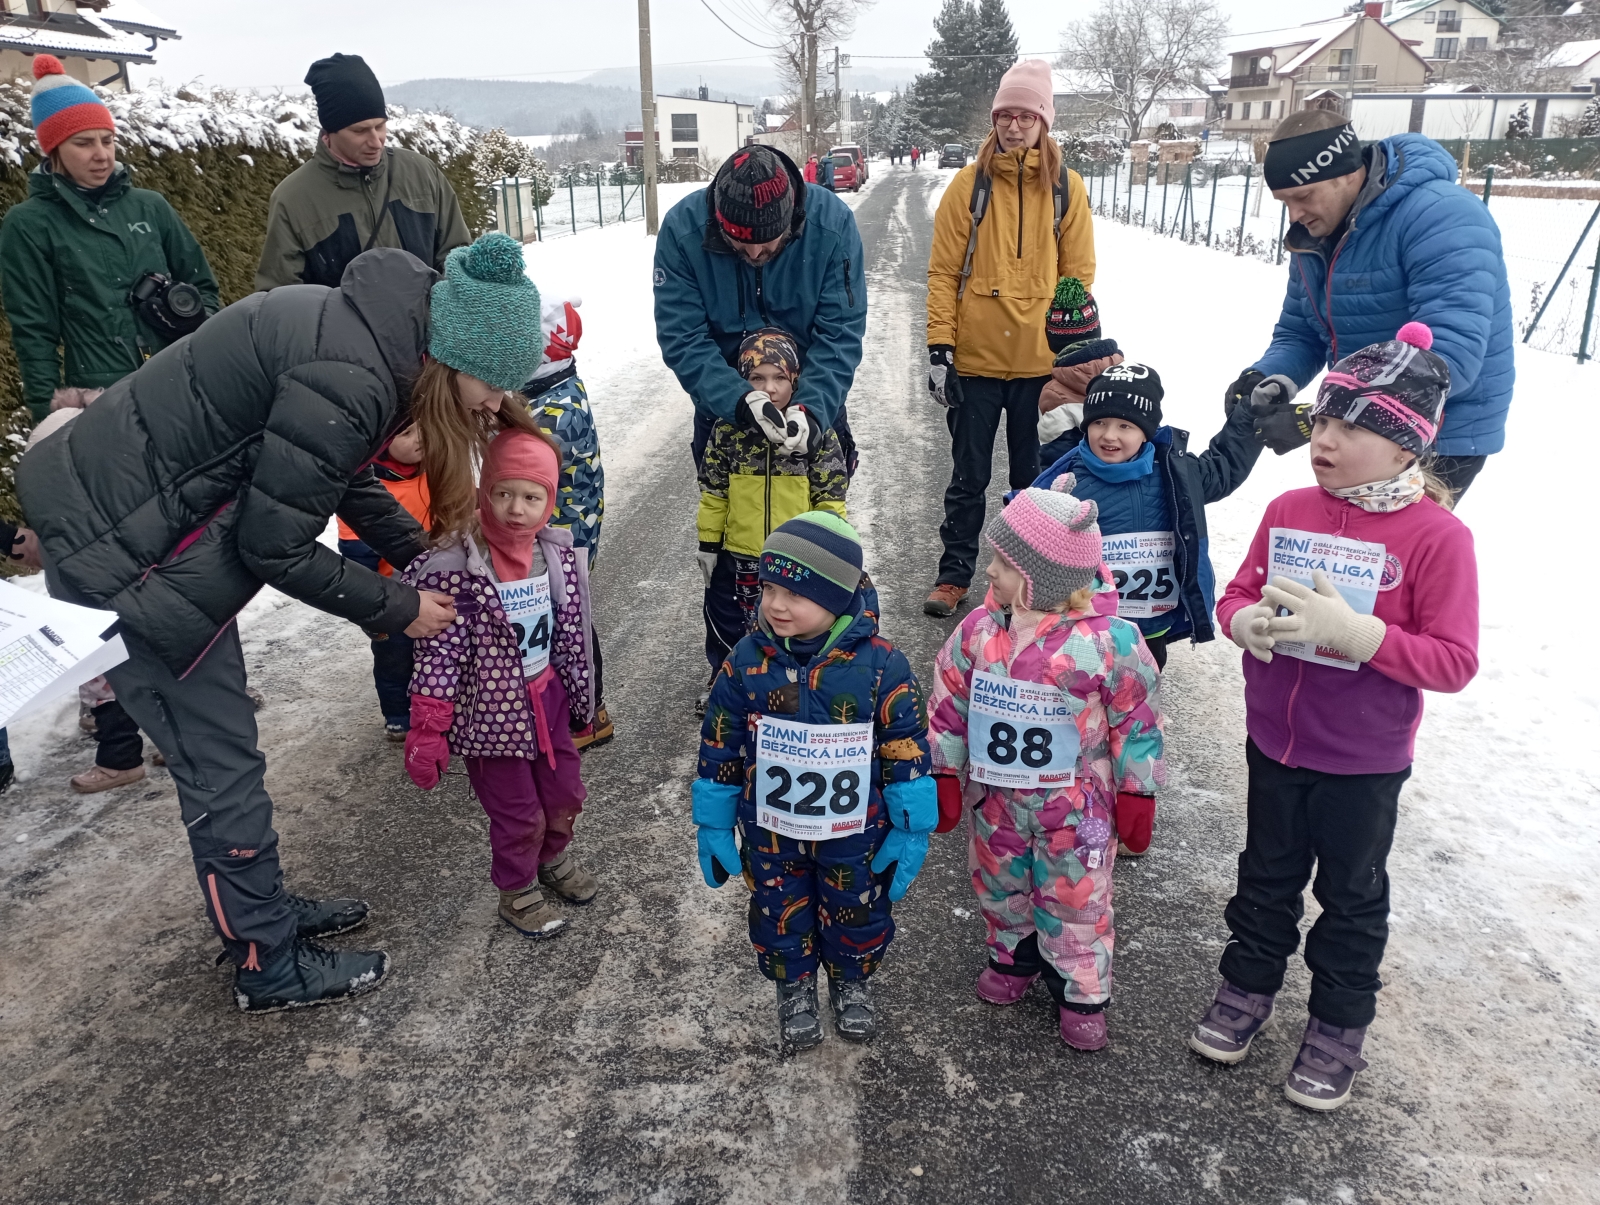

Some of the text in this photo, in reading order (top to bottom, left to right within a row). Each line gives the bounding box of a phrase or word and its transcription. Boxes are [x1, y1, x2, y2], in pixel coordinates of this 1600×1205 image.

[1102, 537, 1138, 551] ZIMNÍ
[1156, 550, 1173, 558] LIGA
[1312, 548, 1379, 564] 2024-2025
[764, 555, 810, 579] MONSTER
[767, 564, 802, 581] WORLD
[1332, 562, 1375, 580] LIGA
[500, 583, 534, 600] IMNÍ
[974, 678, 1018, 699] ZIMNÍ
[974, 693, 1039, 715] BĚŽECKÁ
[1020, 693, 1066, 703] 2024-20
[762, 723, 808, 744] ZIMNÍ
[811, 735, 868, 744] 2024-2025
[761, 739, 867, 758] BĚŽECKÁ LIGA
[987, 721, 1053, 768] 88
[1039, 771, 1072, 780] MARATON
[766, 766, 860, 816] 228
[831, 819, 863, 830] MARATON
